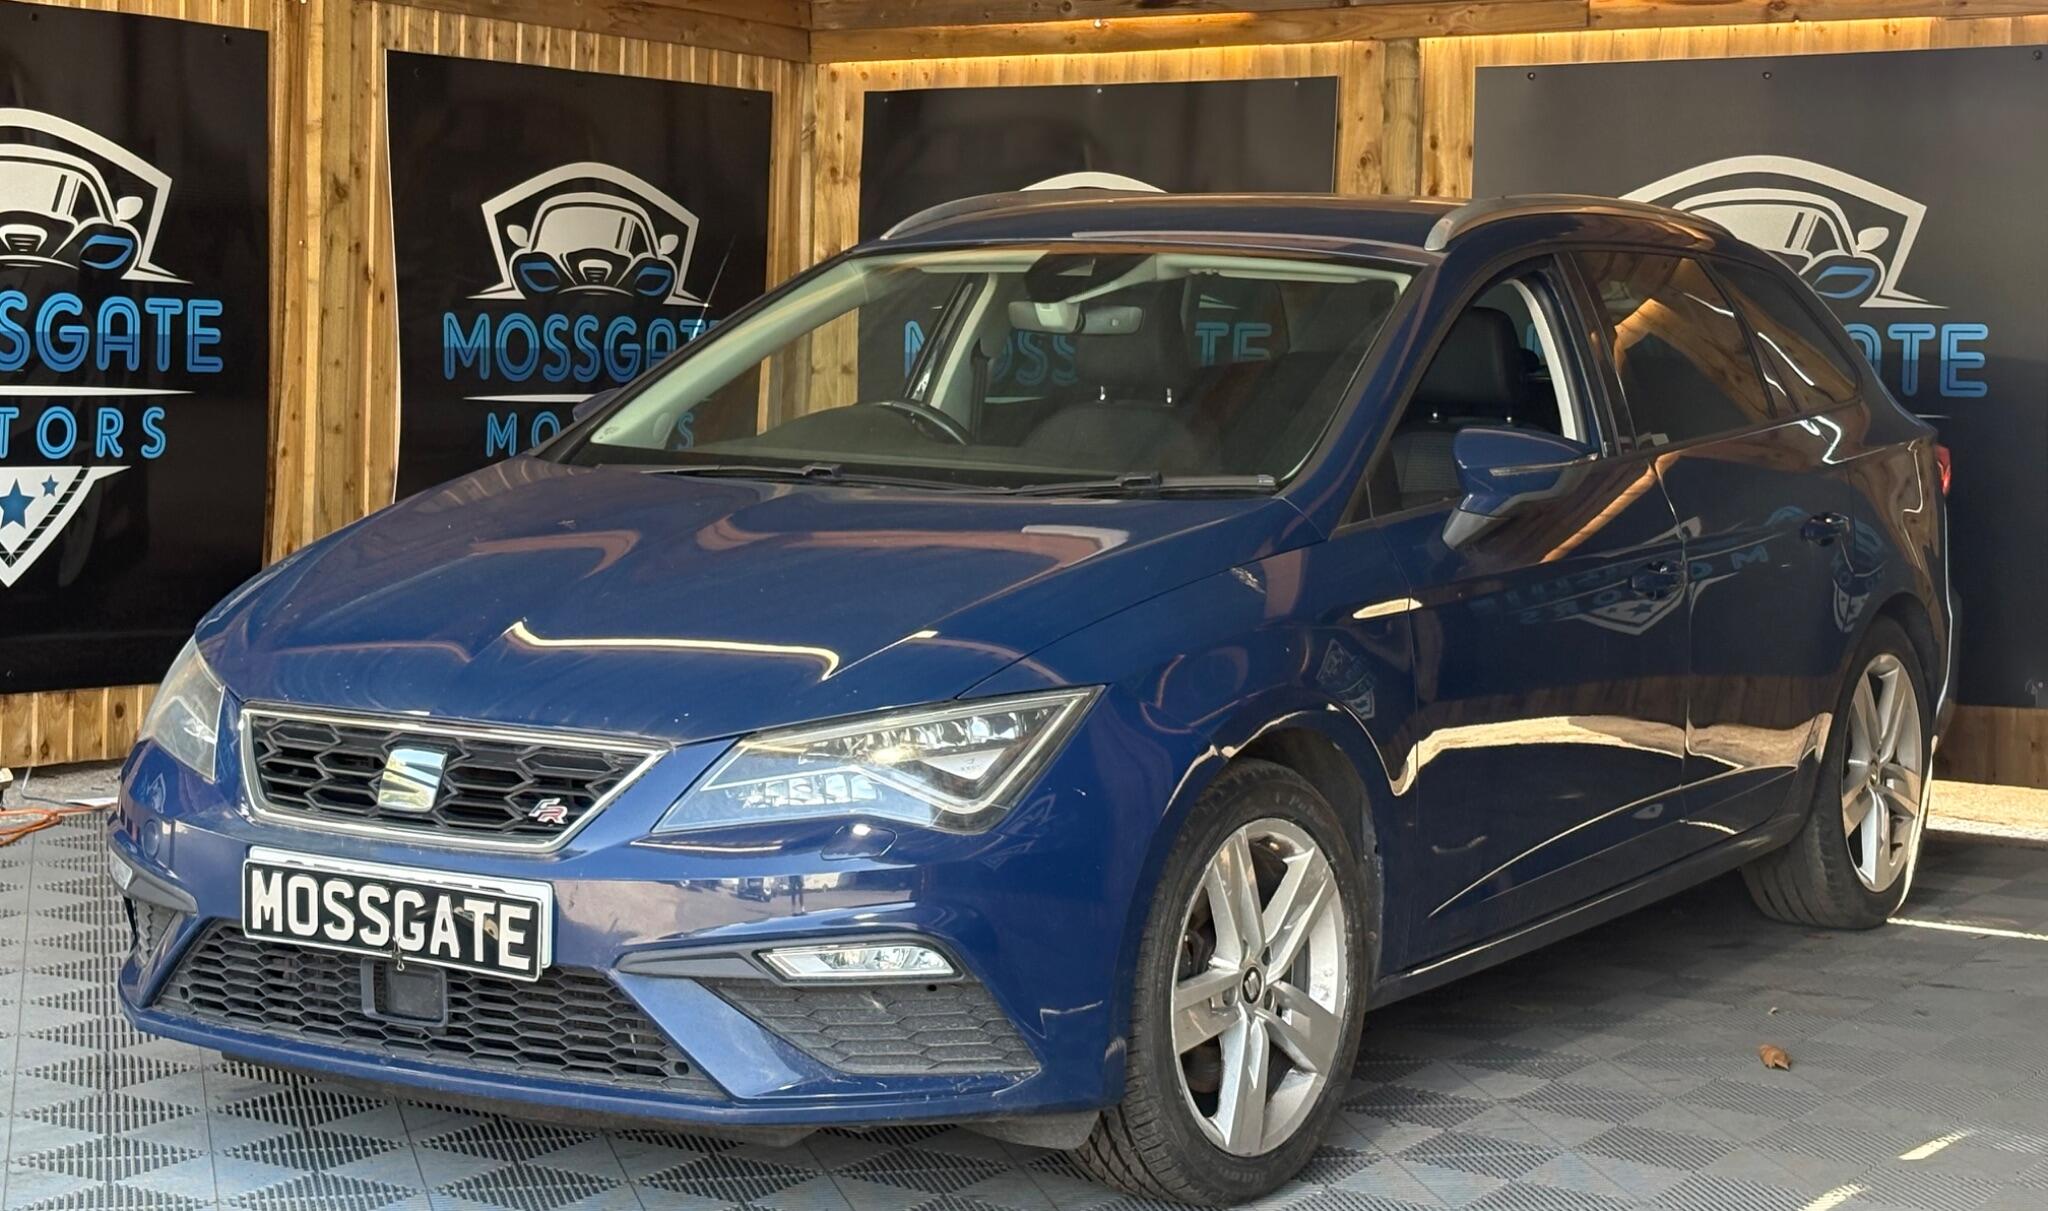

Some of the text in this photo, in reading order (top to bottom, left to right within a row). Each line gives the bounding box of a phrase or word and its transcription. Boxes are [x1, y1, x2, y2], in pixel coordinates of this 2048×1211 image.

[443, 312, 723, 383] MOSSGA
[528, 797, 567, 825] FR
[251, 868, 532, 971] MOSSGATE
